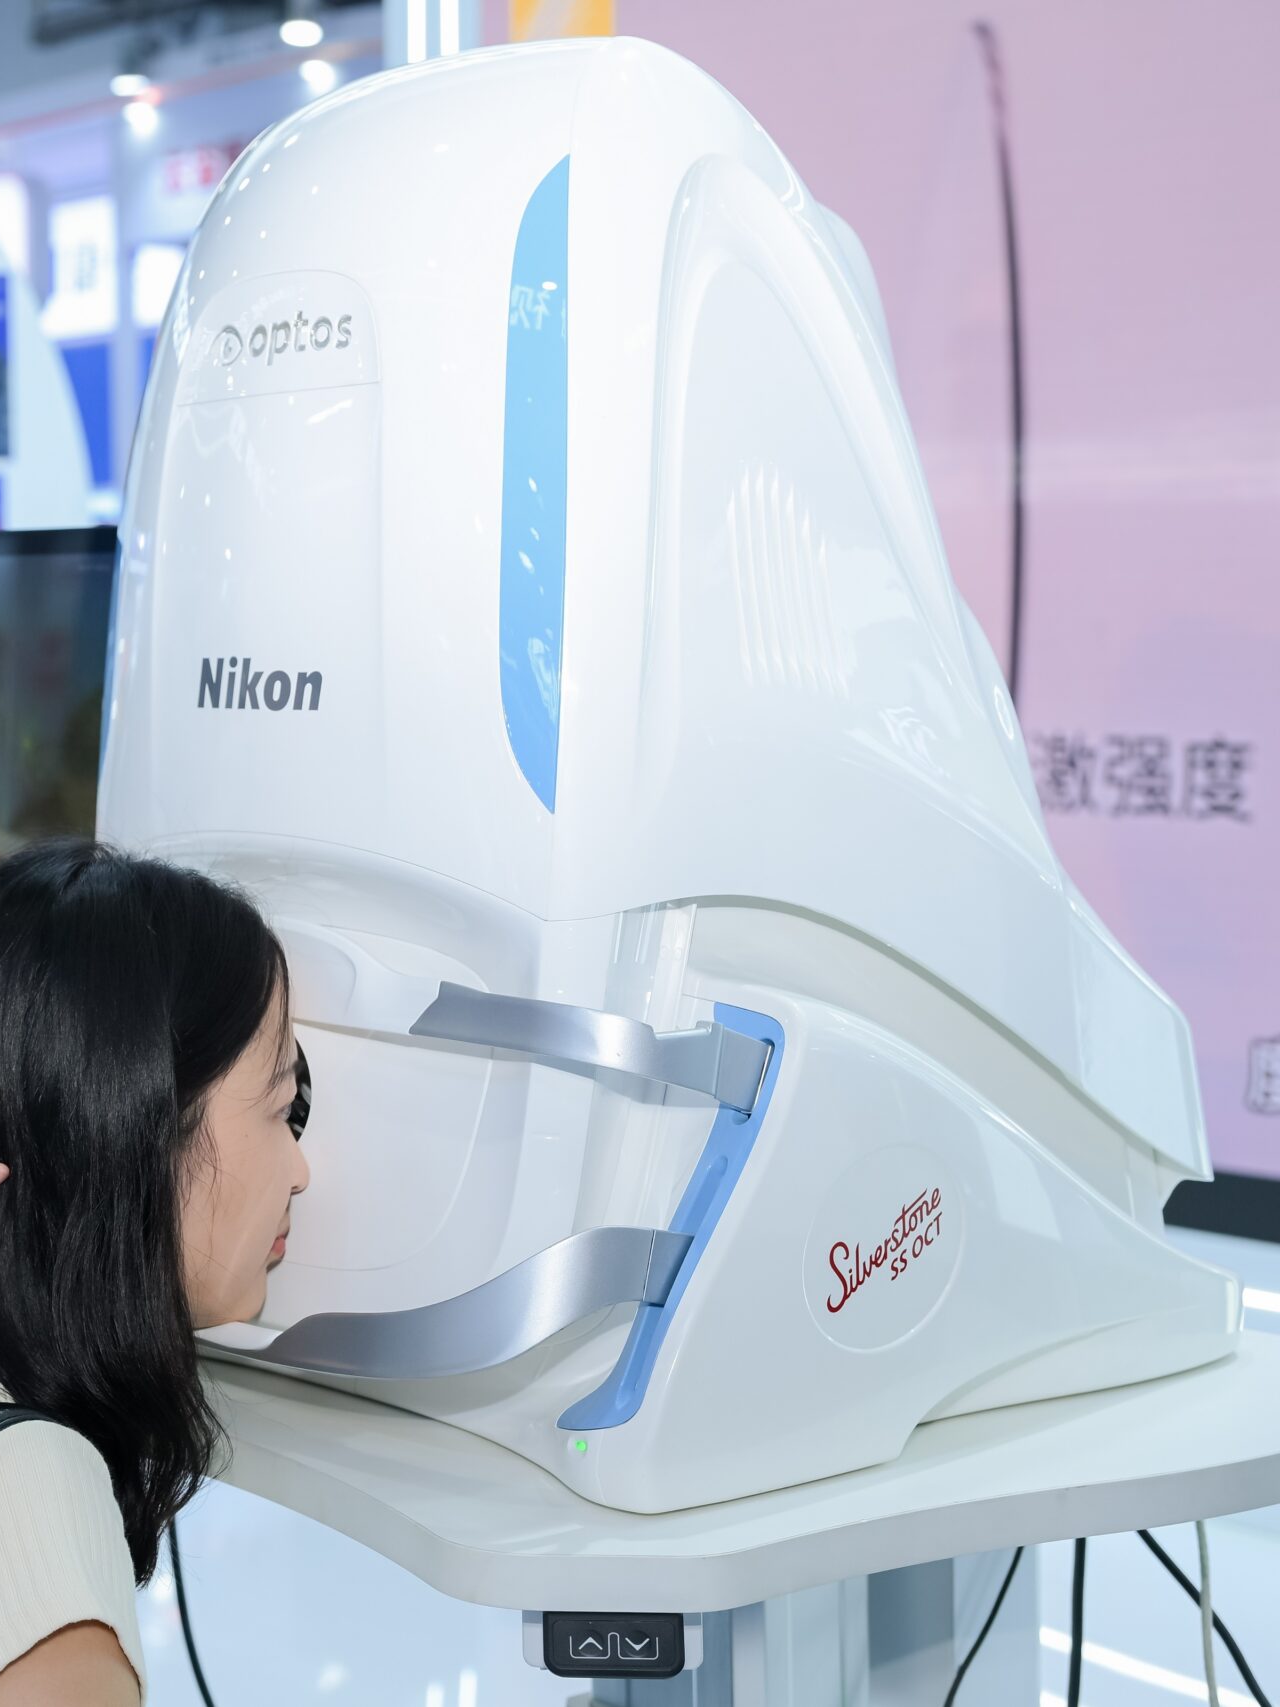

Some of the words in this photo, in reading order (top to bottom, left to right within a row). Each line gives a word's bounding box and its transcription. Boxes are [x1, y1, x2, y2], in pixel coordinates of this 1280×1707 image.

[248, 310, 352, 366] optos
[197, 656, 323, 711] Nikon
[827, 1188, 941, 1313] Silverstone
[891, 1249, 907, 1281] SS
[912, 1212, 943, 1259] OCT
